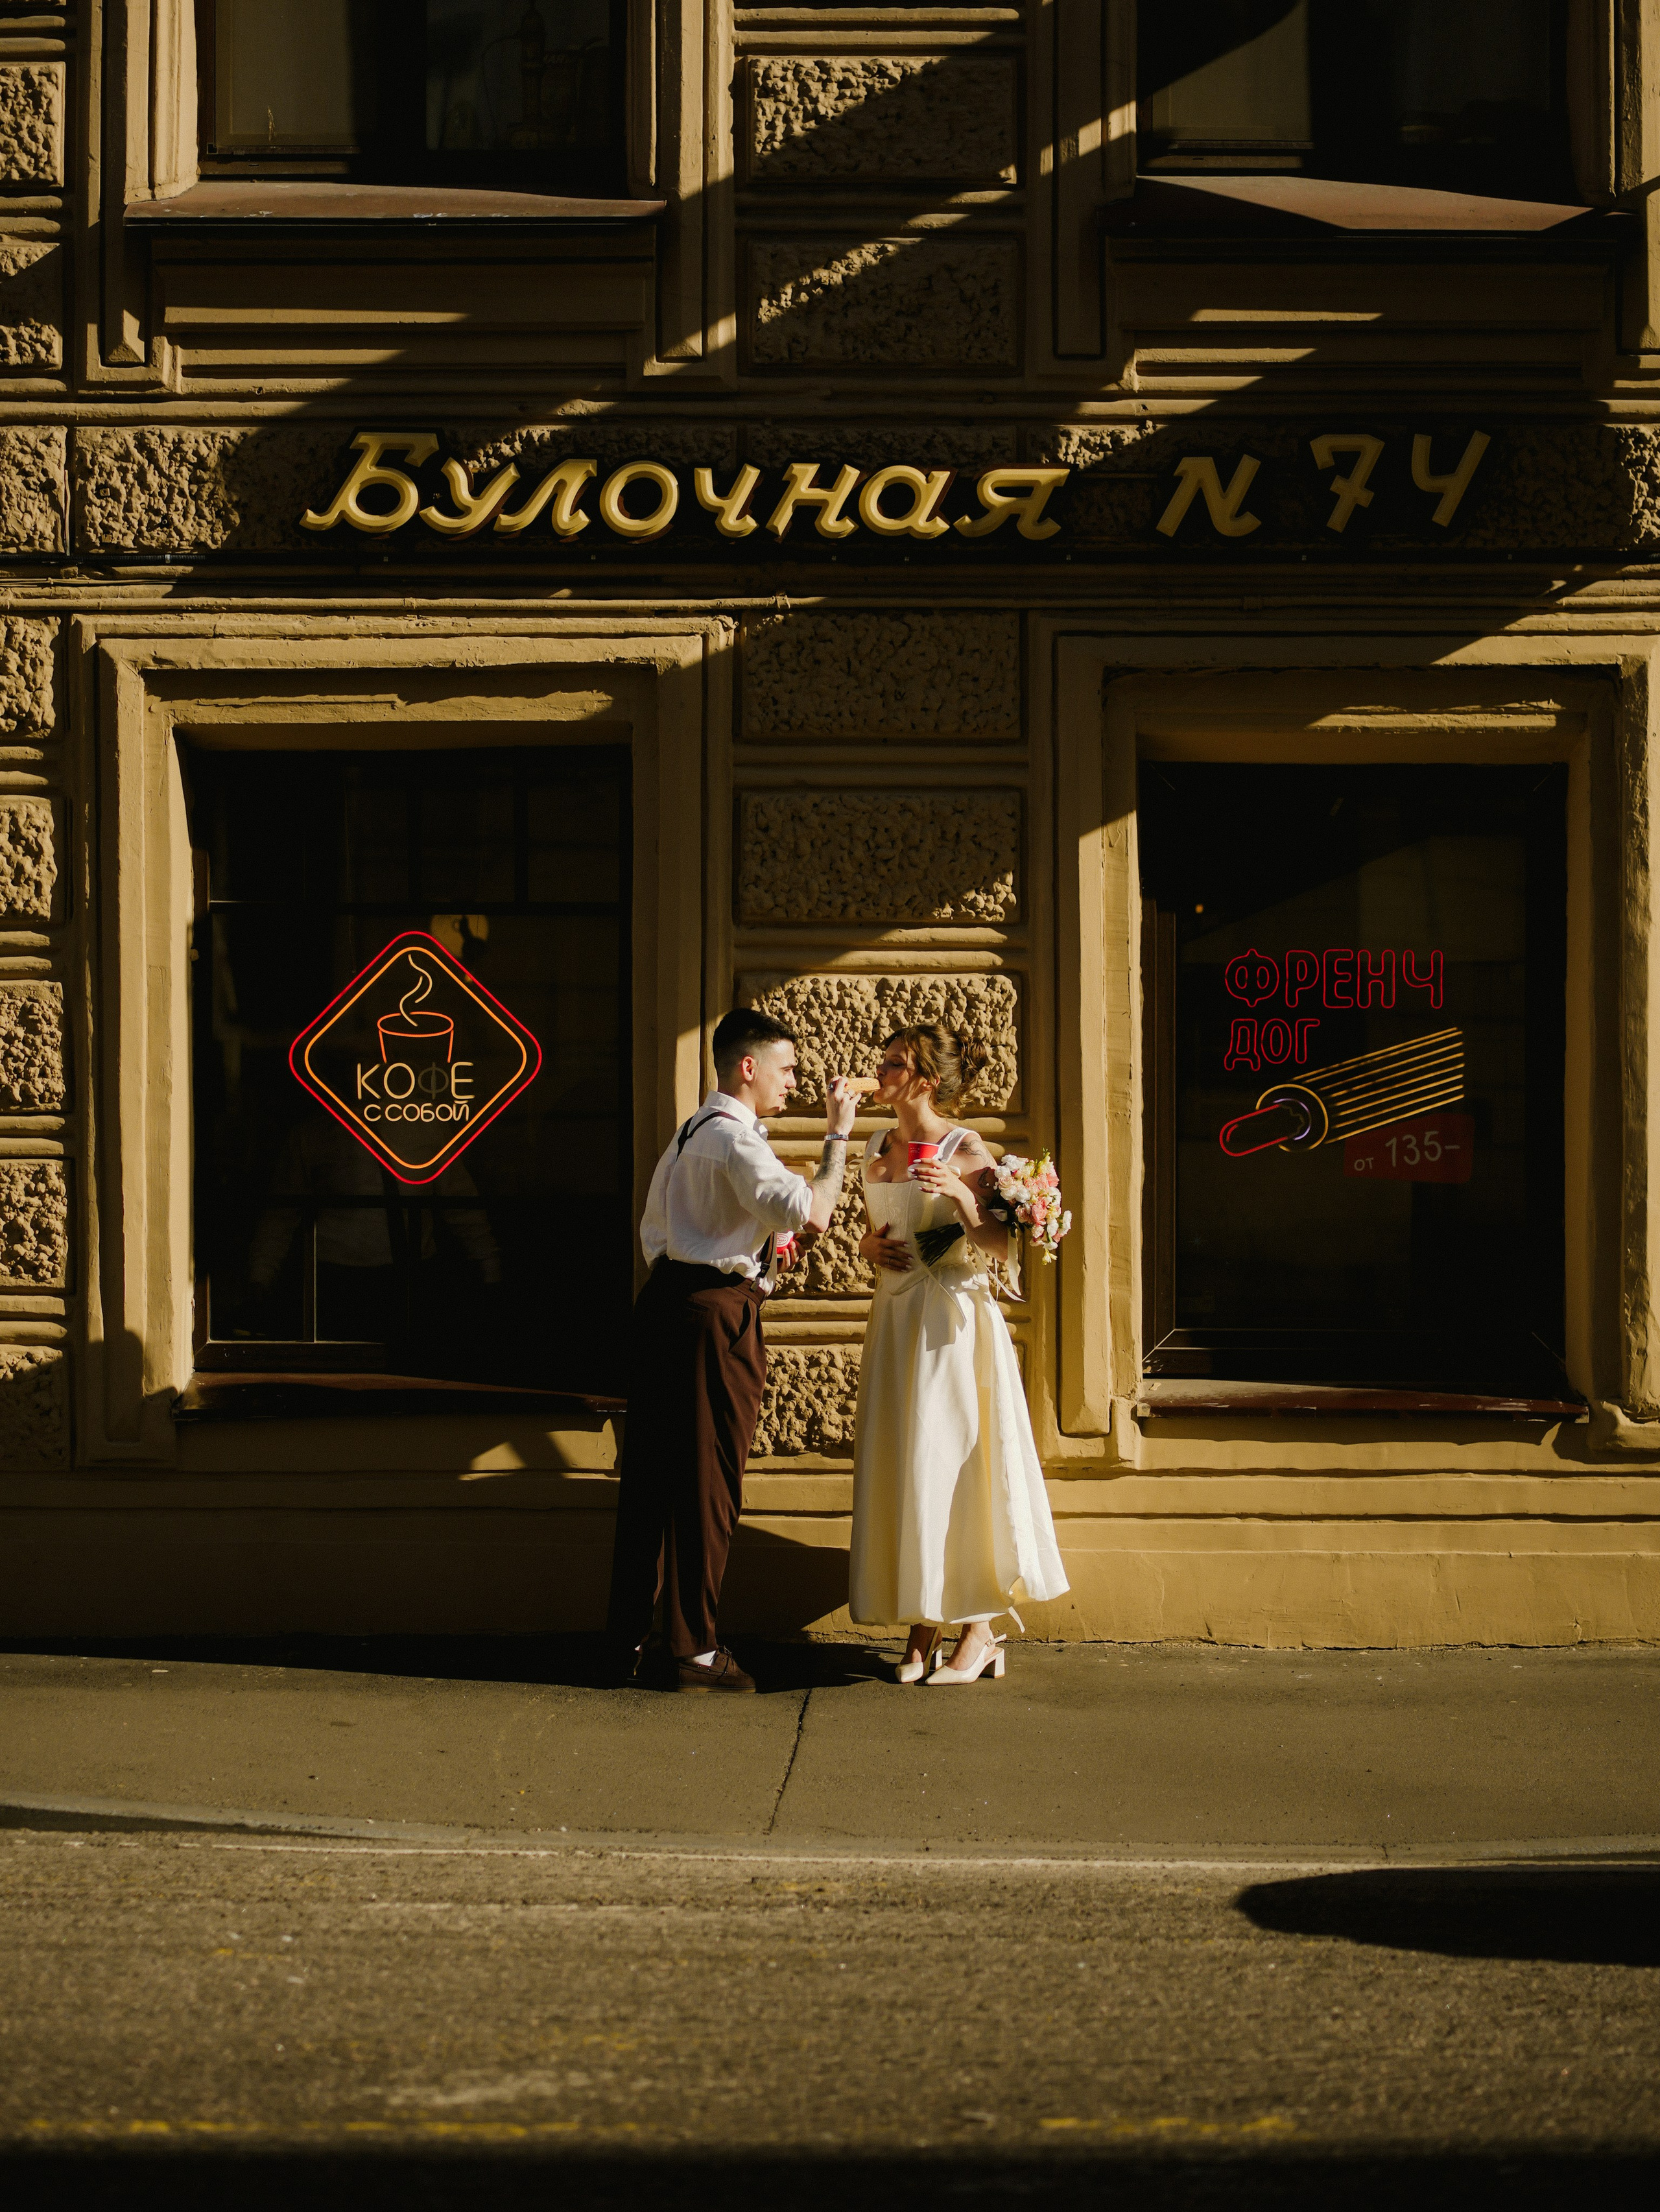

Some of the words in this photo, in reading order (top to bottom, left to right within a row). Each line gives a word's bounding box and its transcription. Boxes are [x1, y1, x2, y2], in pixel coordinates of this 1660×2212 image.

[298, 431, 1071, 542] Булочная
[1155, 453, 1262, 538] N
[1309, 429, 1491, 534] 74
[1225, 948, 1443, 1010] ФРЕНЧ
[1224, 1017, 1321, 1072] ДОГ
[357, 1061, 476, 1100] КОФЕ
